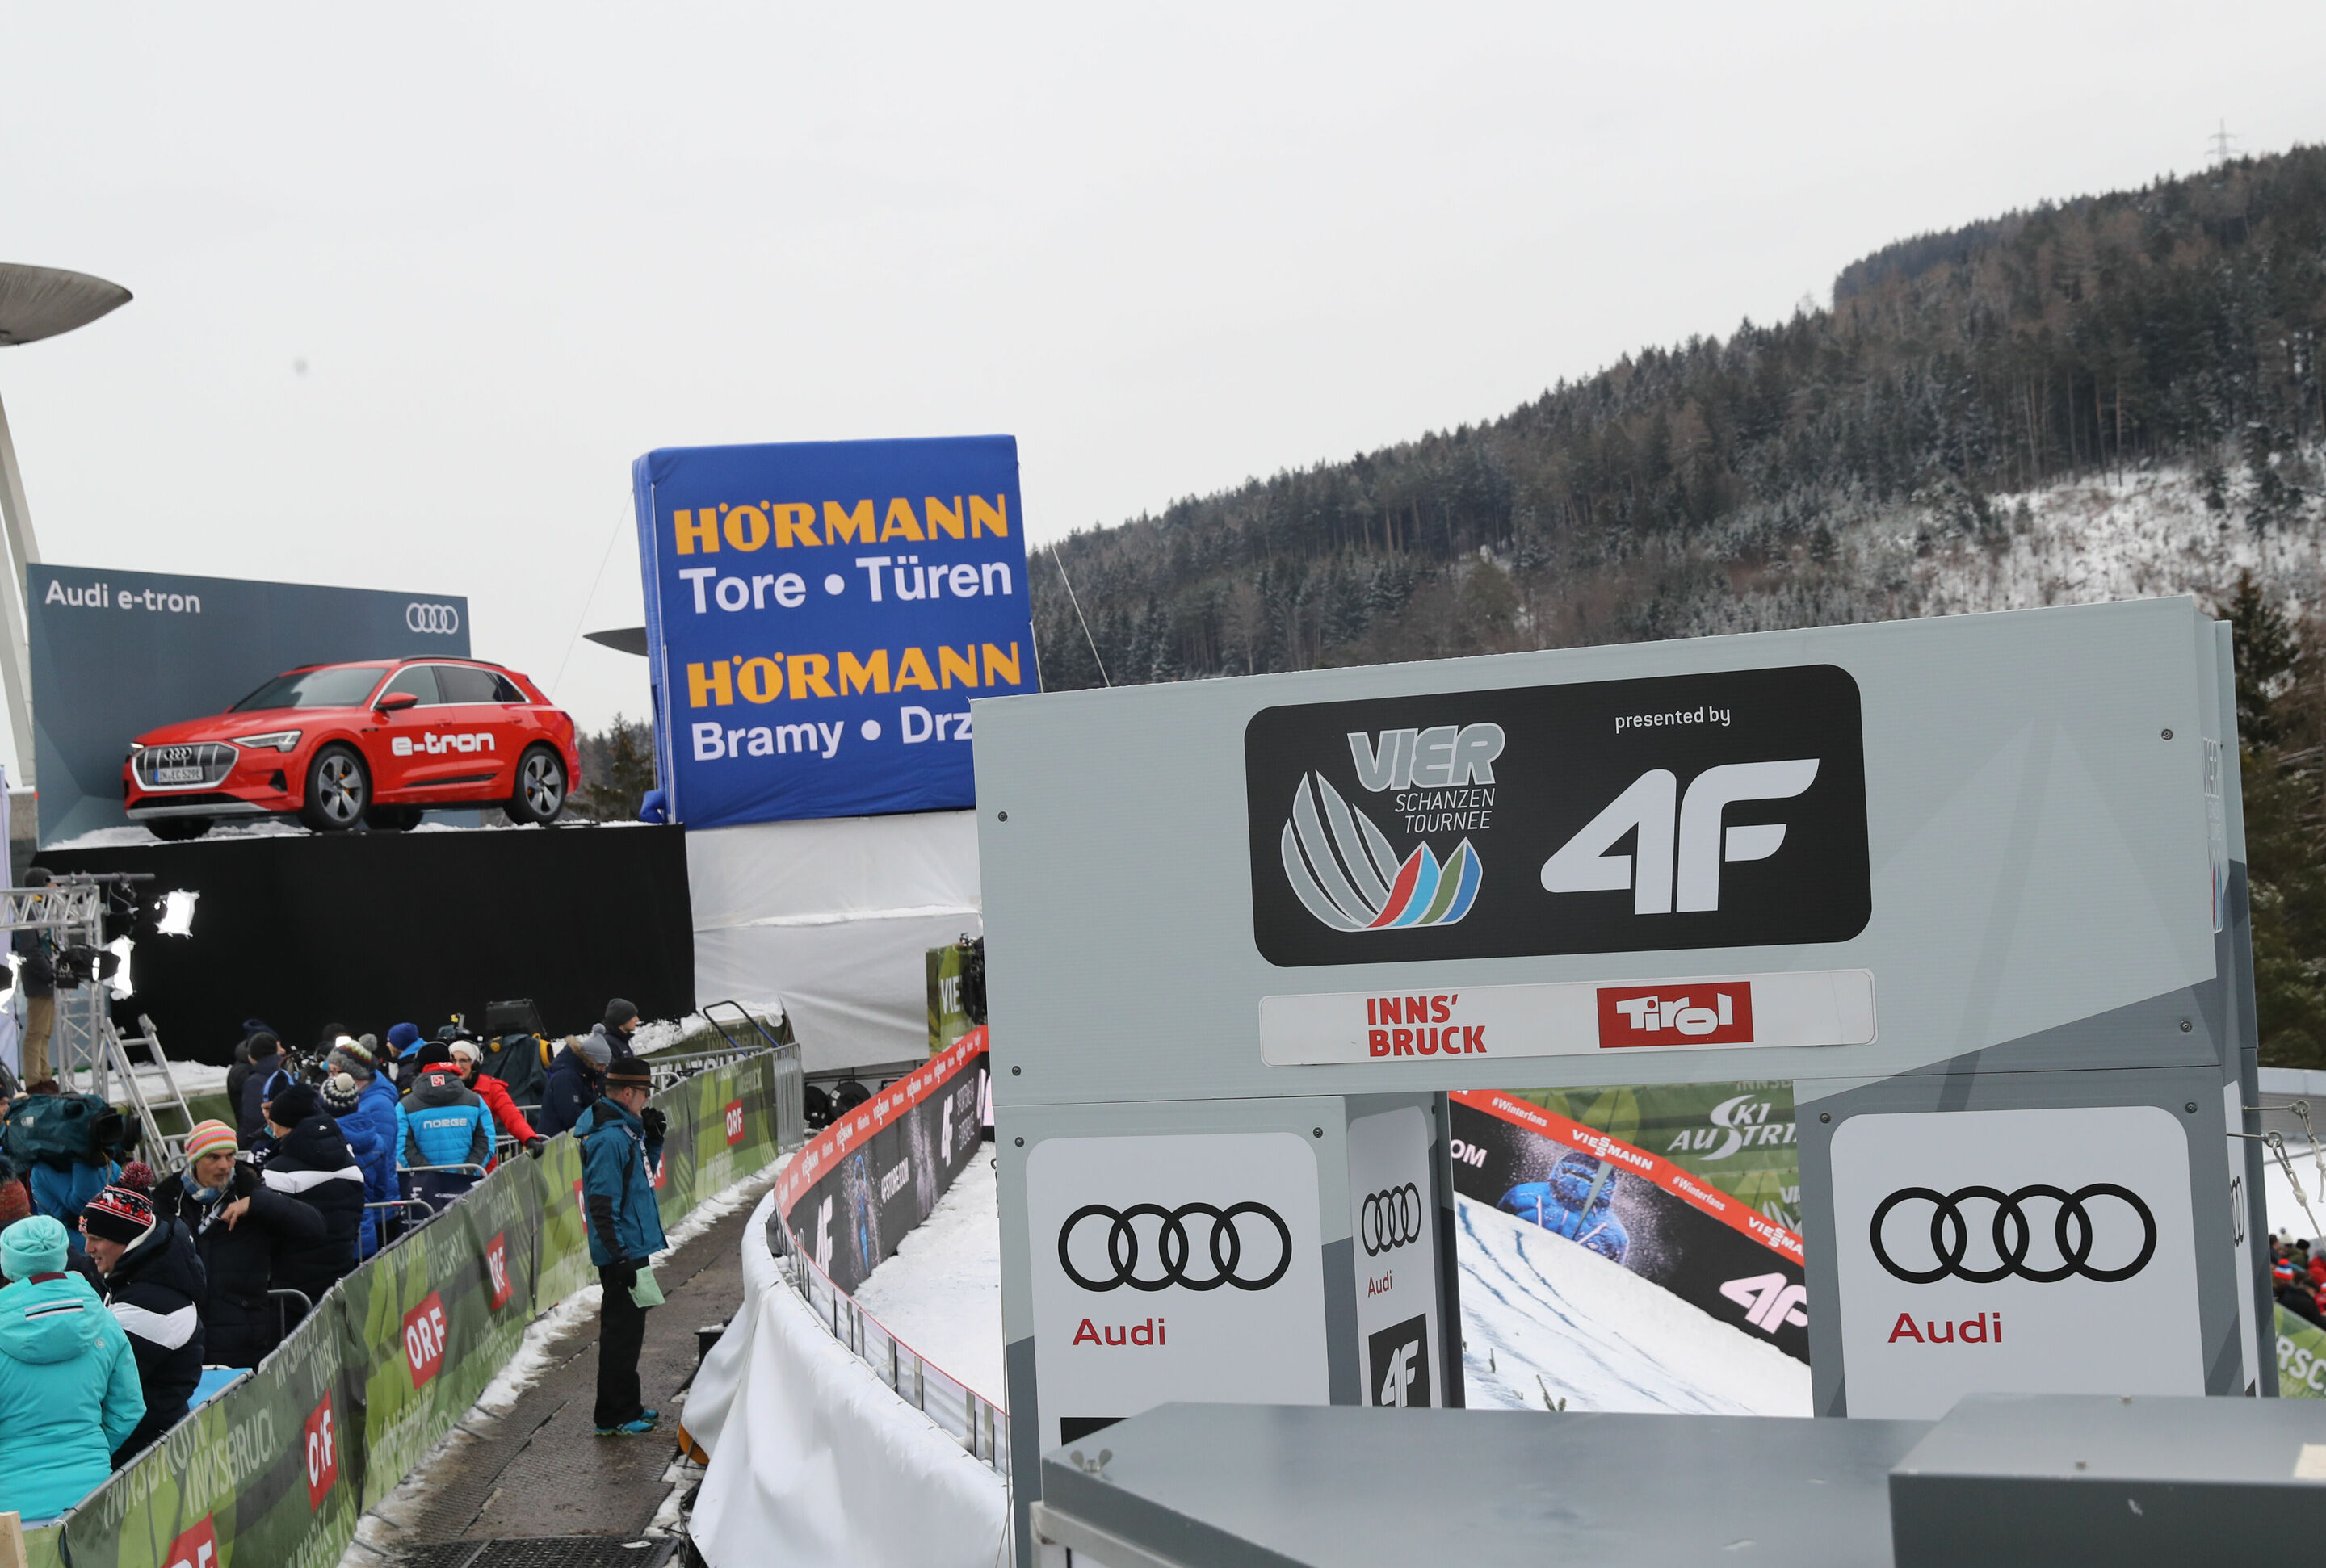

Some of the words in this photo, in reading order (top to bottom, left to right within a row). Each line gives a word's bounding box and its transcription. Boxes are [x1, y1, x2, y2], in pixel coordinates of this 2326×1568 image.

[674, 493, 1009, 555] HÖRMANN
[45, 579, 109, 608] Audi
[117, 588, 201, 614] e-tron
[679, 567, 807, 614] Tore
[855, 555, 1013, 602] Türen
[686, 641, 1022, 709] HÖRMANN
[691, 721, 845, 761] Bramy
[900, 705, 972, 744] Drz
[1615, 706, 1704, 734] presented
[1709, 706, 1731, 727] by
[391, 732, 495, 757] e-tron
[1347, 722, 1506, 793] VIER
[1395, 788, 1496, 812] SCHANZEN
[1404, 810, 1493, 834] TOURNEE
[1540, 758, 1820, 916] 4F
[1367, 993, 1459, 1025] INNS'
[1615, 992, 1734, 1036] Tirol
[1367, 1025, 1488, 1058] BRUCK
[727, 1107, 742, 1137] ORF
[1491, 1096, 1548, 1128] #Winterfans
[1572, 1128, 1654, 1171] VIESSMANN
[1672, 1176, 1726, 1211] #Winterfans
[1368, 1269, 1393, 1298] Audi
[407, 1306, 446, 1370] ORF
[1072, 1318, 1166, 1346] Audi
[1887, 1312, 2002, 1344] Audi
[1380, 1339, 1419, 1407] 4F
